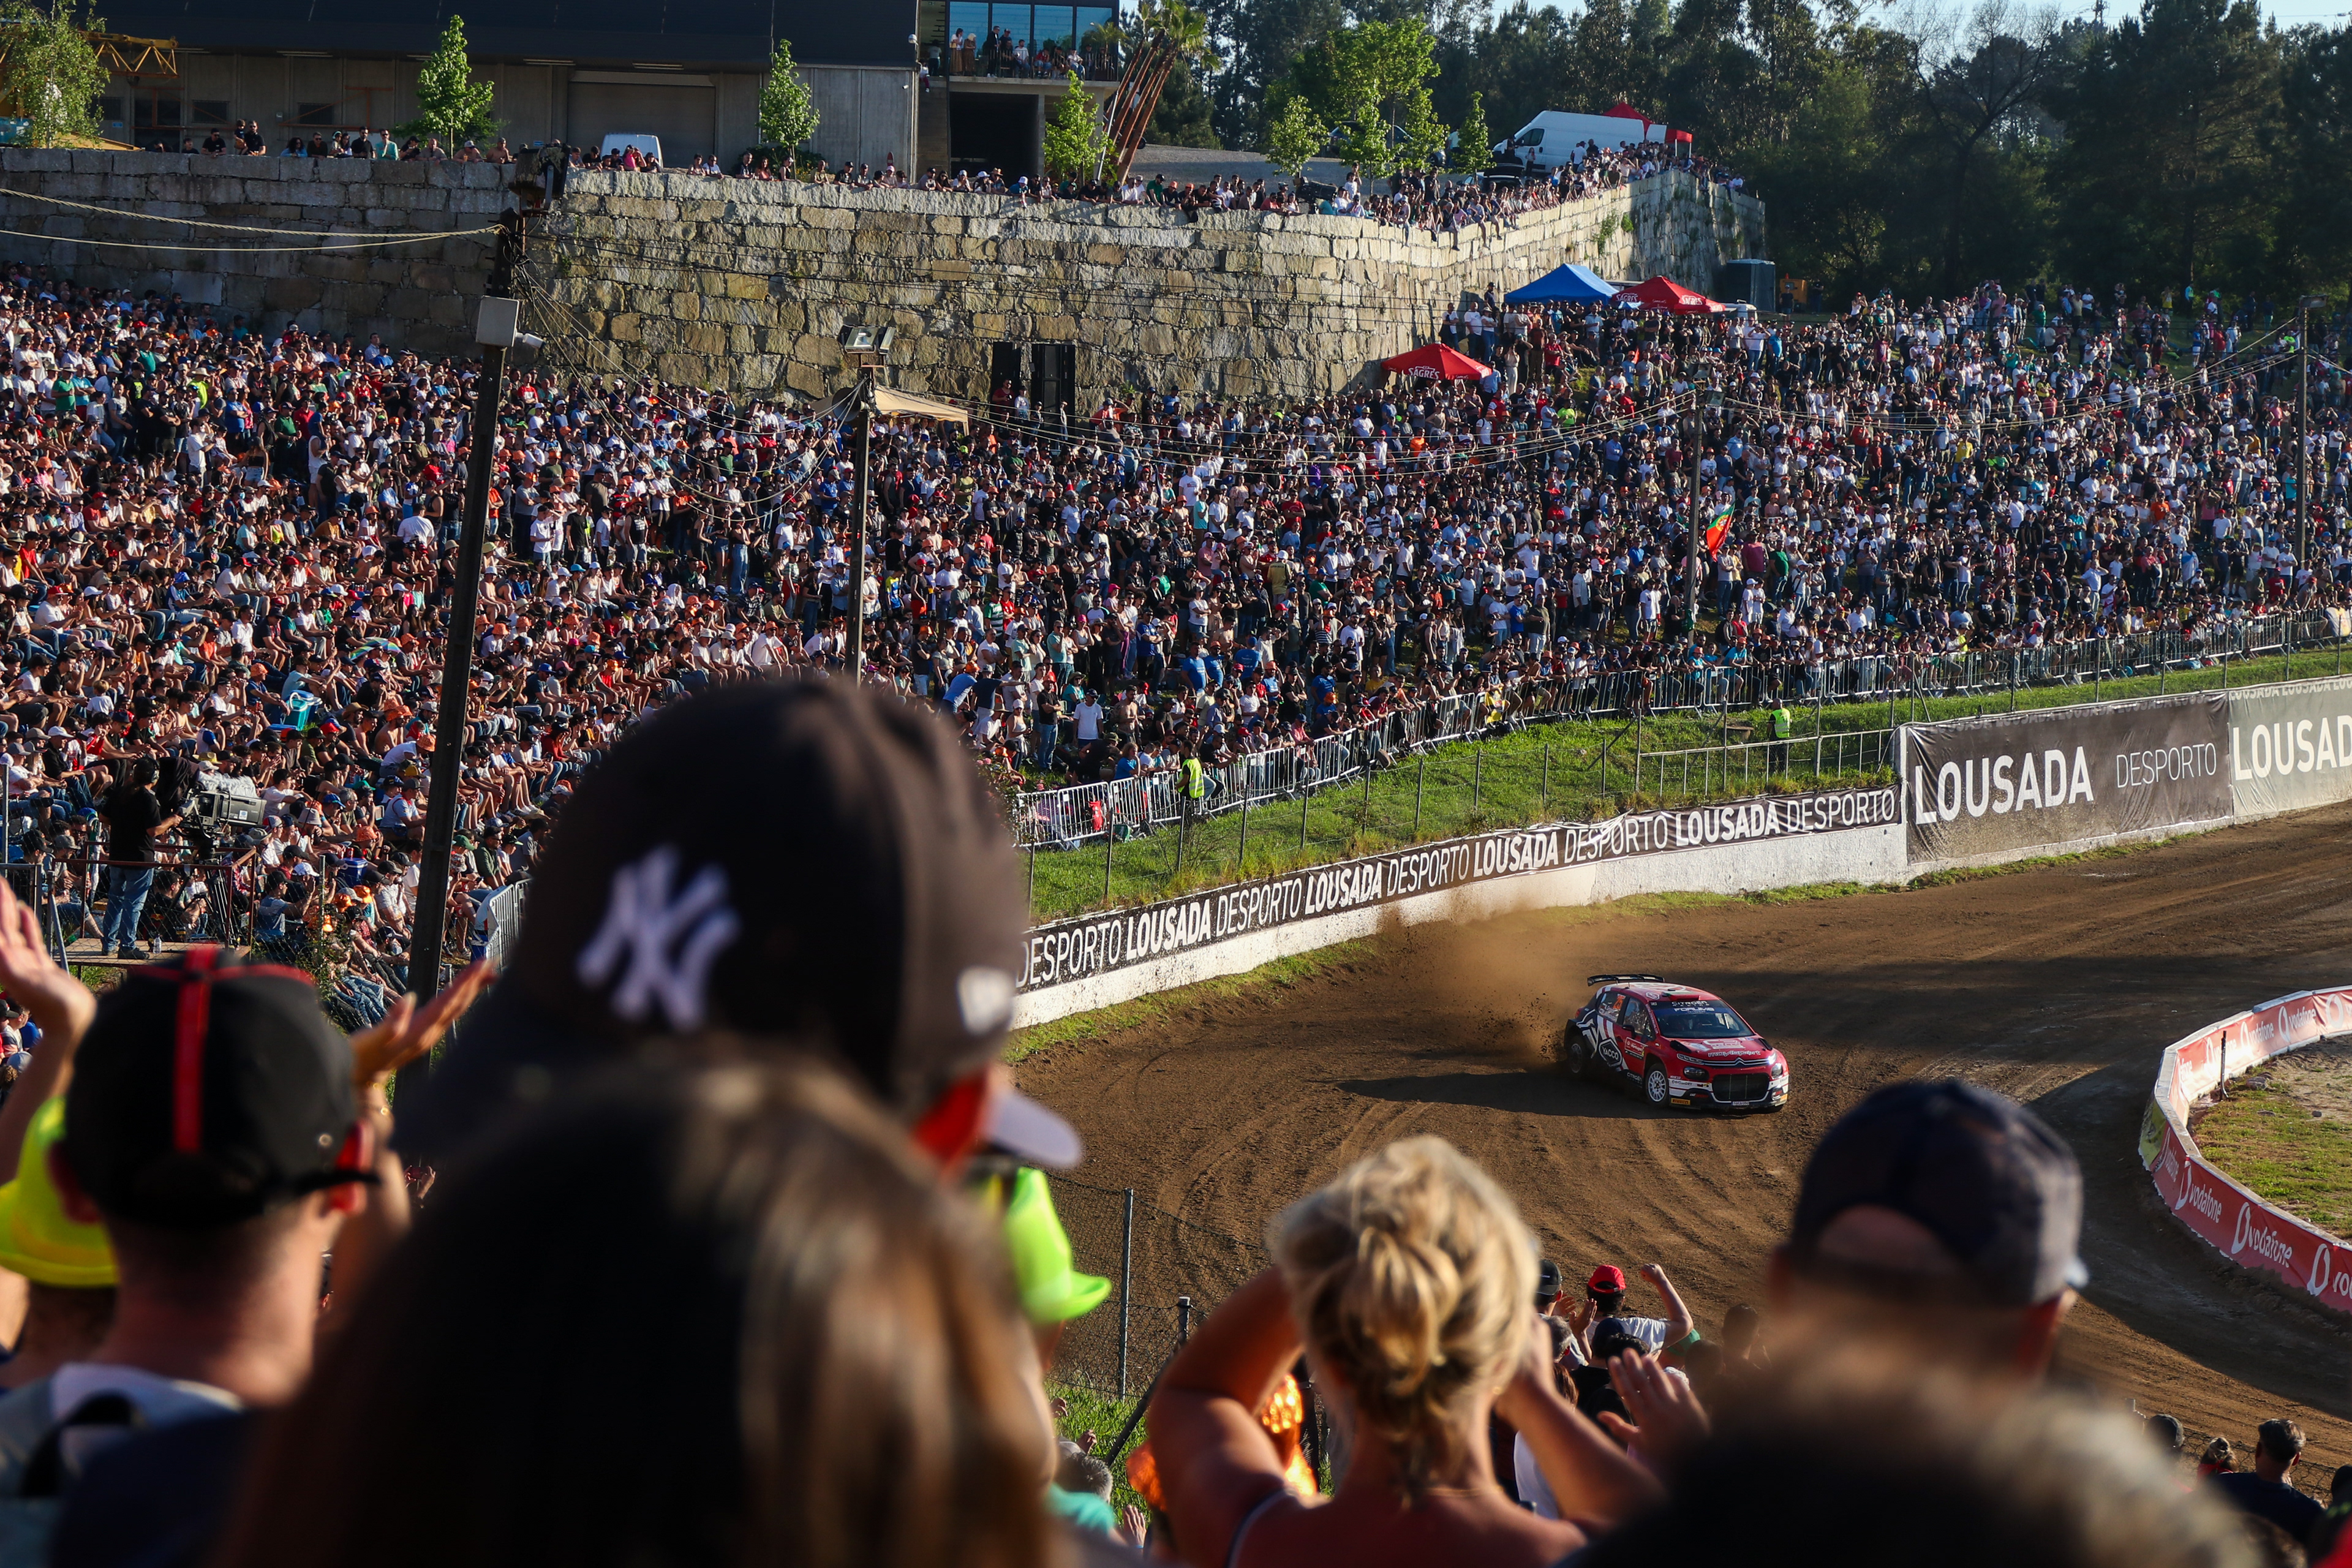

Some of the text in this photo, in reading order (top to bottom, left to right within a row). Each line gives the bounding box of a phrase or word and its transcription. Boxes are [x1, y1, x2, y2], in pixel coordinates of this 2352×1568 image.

[1409, 368, 1440, 380] SAGRES
[2233, 714, 2352, 781] LOUSAD
[1915, 742, 2217, 824] LOUSADA DESPORTO
[1016, 789, 1895, 988] DESPORTO LOUSADA DESPORTO LOUSADA DESPORTO LOUSADA DESPORTO LOUSADA DESPORTO
[2249, 1021, 2275, 1043] vodafone
[2289, 1006, 2316, 1029] vodafone
[1602, 1046, 1619, 1060] YACCO
[2189, 1184, 2222, 1223] vodafone
[2248, 1226, 2293, 1268] vodafone
